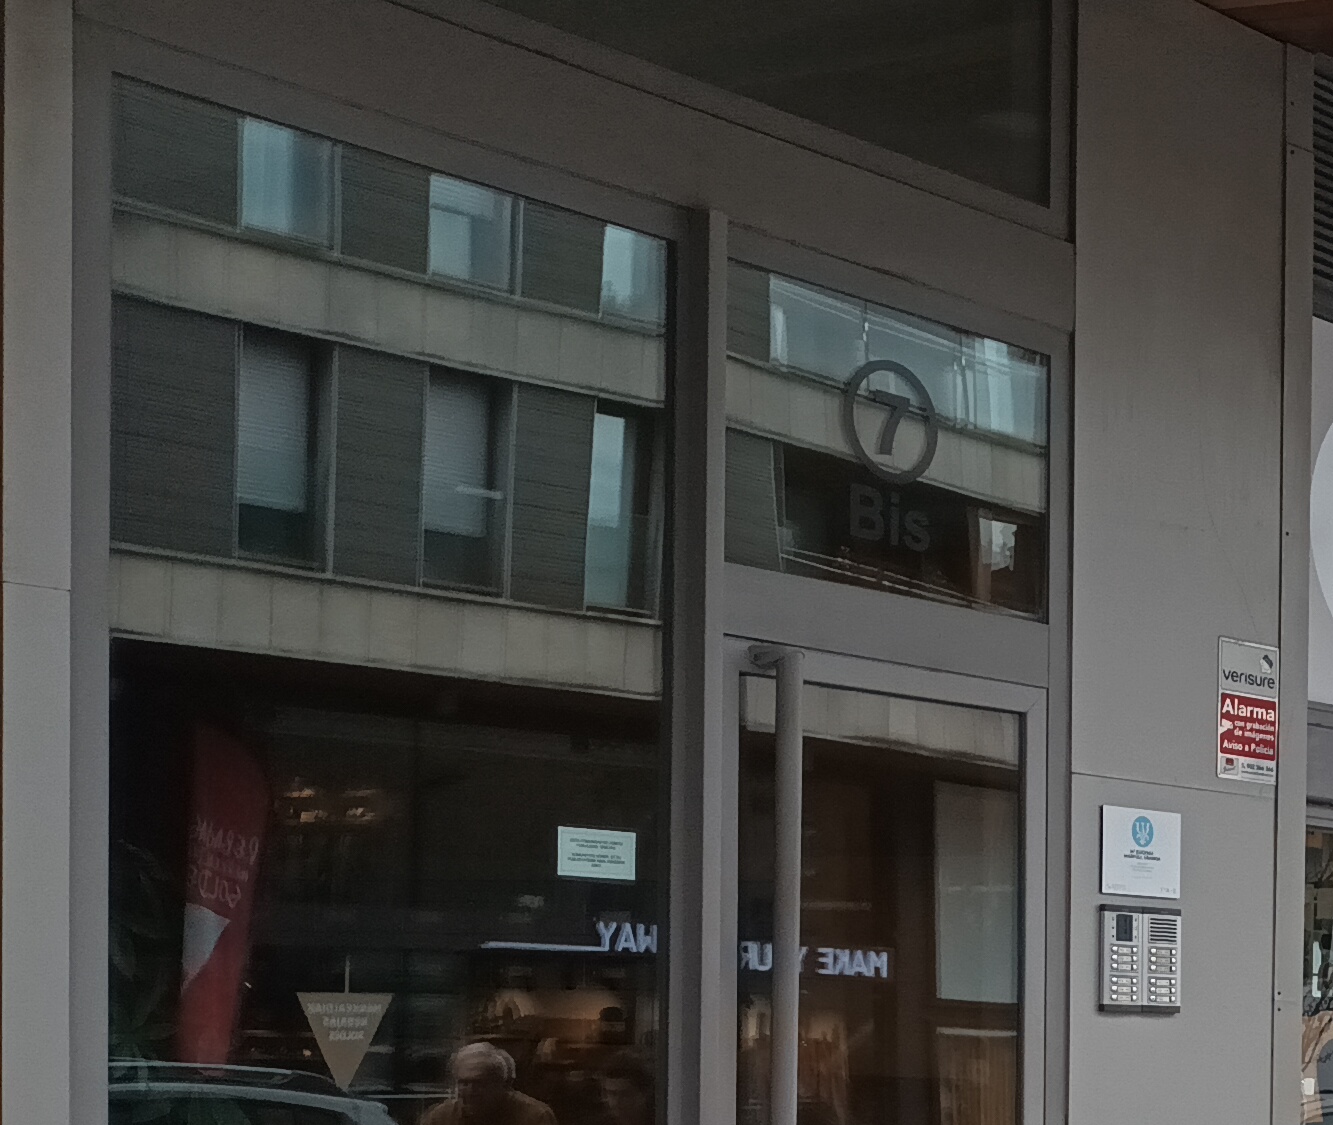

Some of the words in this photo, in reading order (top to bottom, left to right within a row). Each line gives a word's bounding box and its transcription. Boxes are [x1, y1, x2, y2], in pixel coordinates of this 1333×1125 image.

[873, 389, 912, 457] 7
[848, 483, 932, 554] Bis
[1222, 669, 1276, 690] verisure
[1221, 697, 1275, 722] Alarma
[1233, 727, 1243, 736] de
[1222, 738, 1243, 752] Aviso
